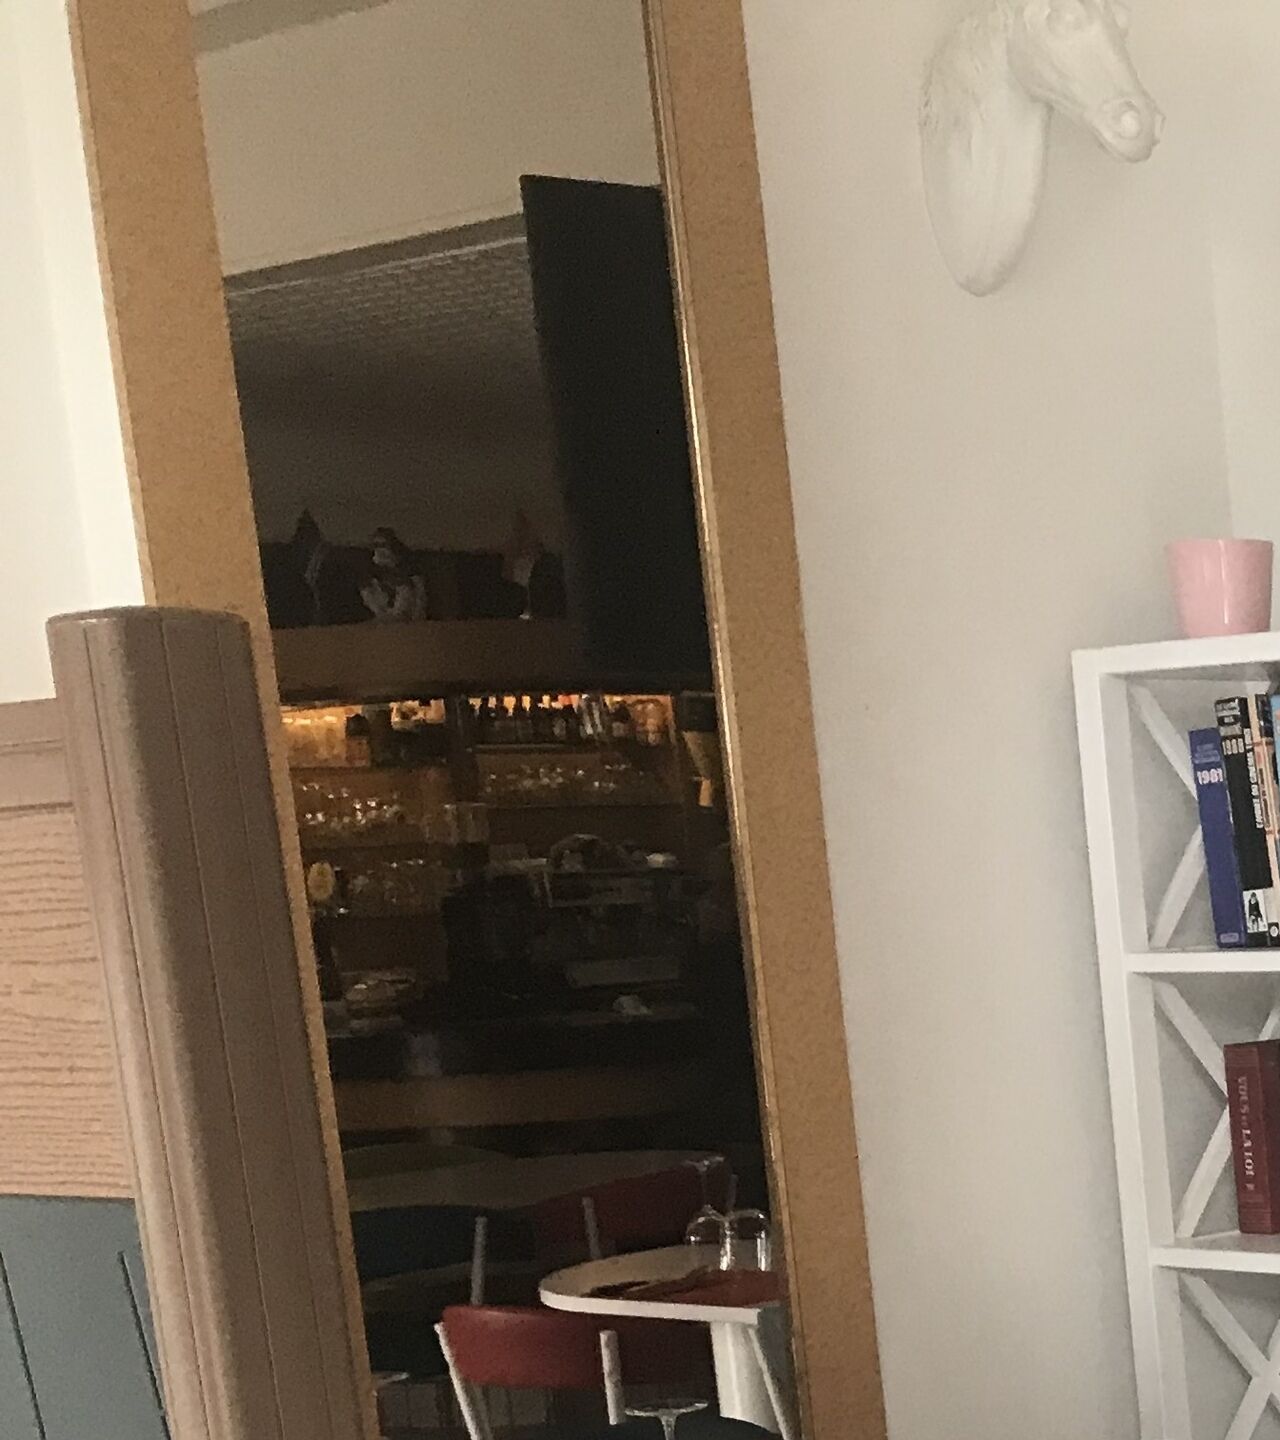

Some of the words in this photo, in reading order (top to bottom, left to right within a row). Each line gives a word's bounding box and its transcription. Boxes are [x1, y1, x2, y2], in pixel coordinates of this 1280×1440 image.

[1237, 1076, 1250, 1115] VOUS
[1241, 1129, 1253, 1151] LA
[1244, 1154, 1255, 1177] LOI
